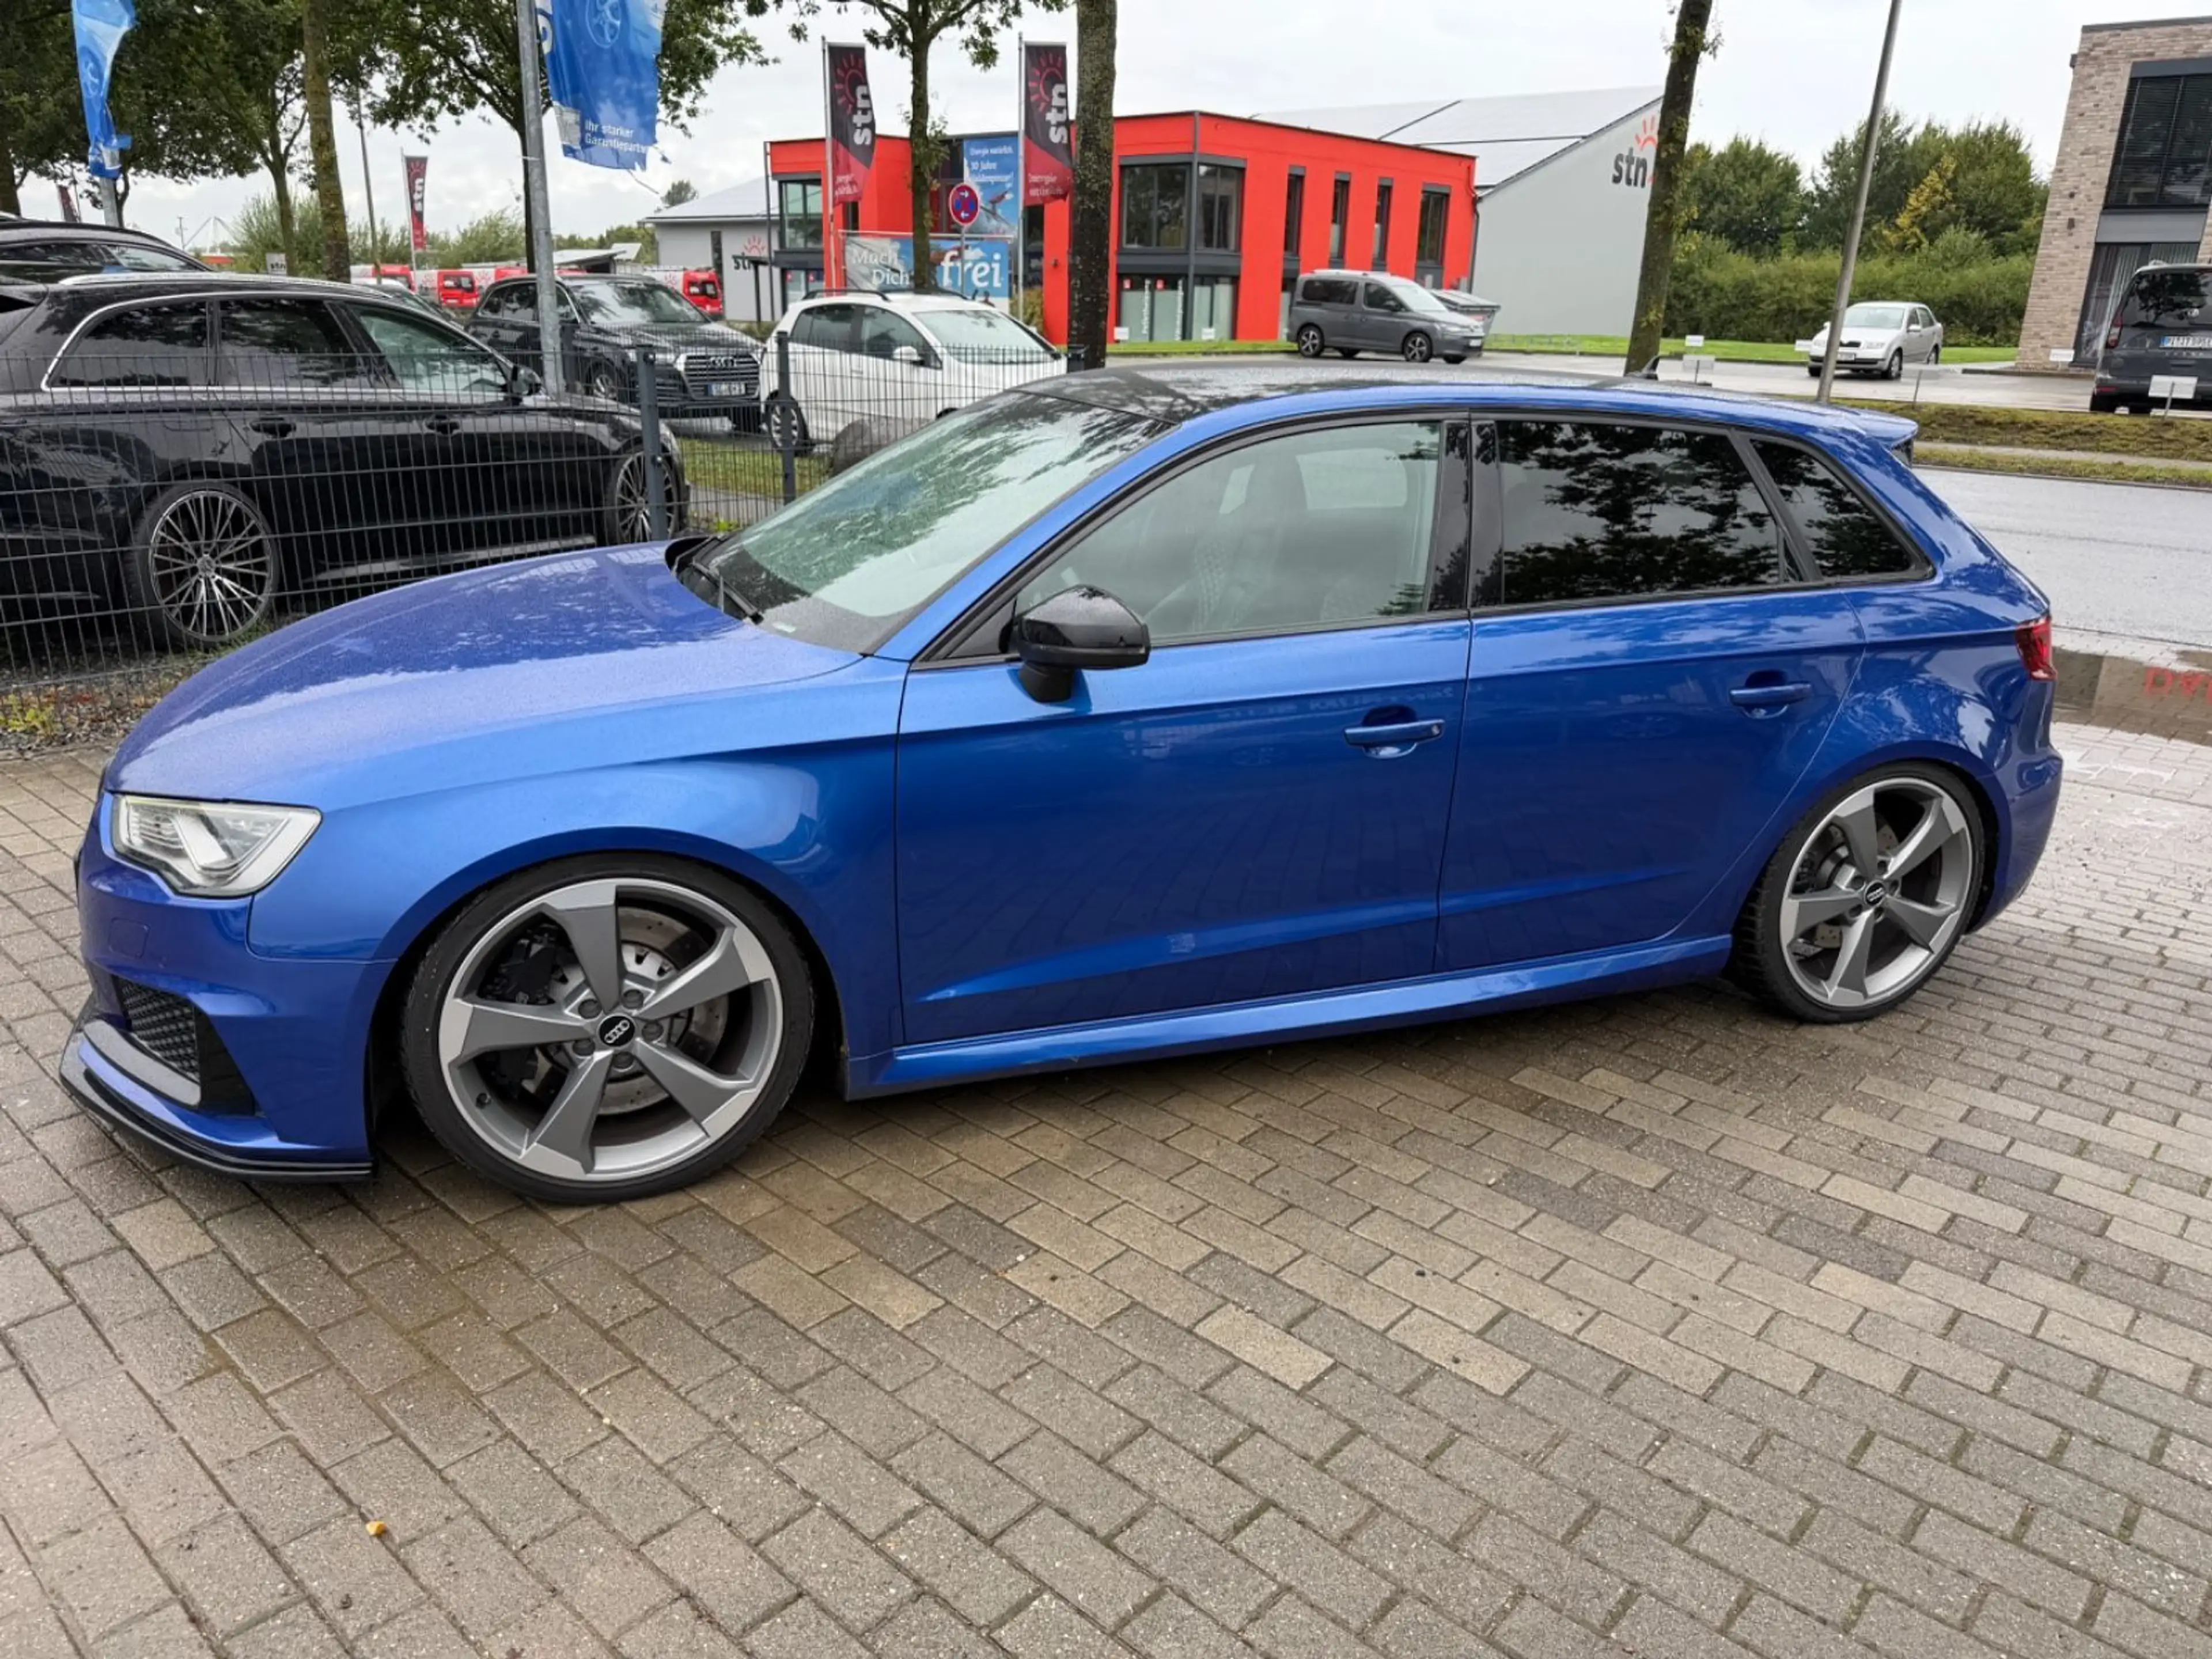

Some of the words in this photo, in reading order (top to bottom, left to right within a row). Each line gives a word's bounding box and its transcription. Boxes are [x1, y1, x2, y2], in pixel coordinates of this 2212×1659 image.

[584, 118, 599, 132] Ihr
[601, 124, 634, 138] starker
[853, 85, 872, 145] stn
[1046, 84, 1068, 143] stn
[1612, 146, 1647, 188] stn
[852, 248, 897, 264] Mach
[940, 249, 1002, 287] frei
[871, 269, 910, 286] Dich
